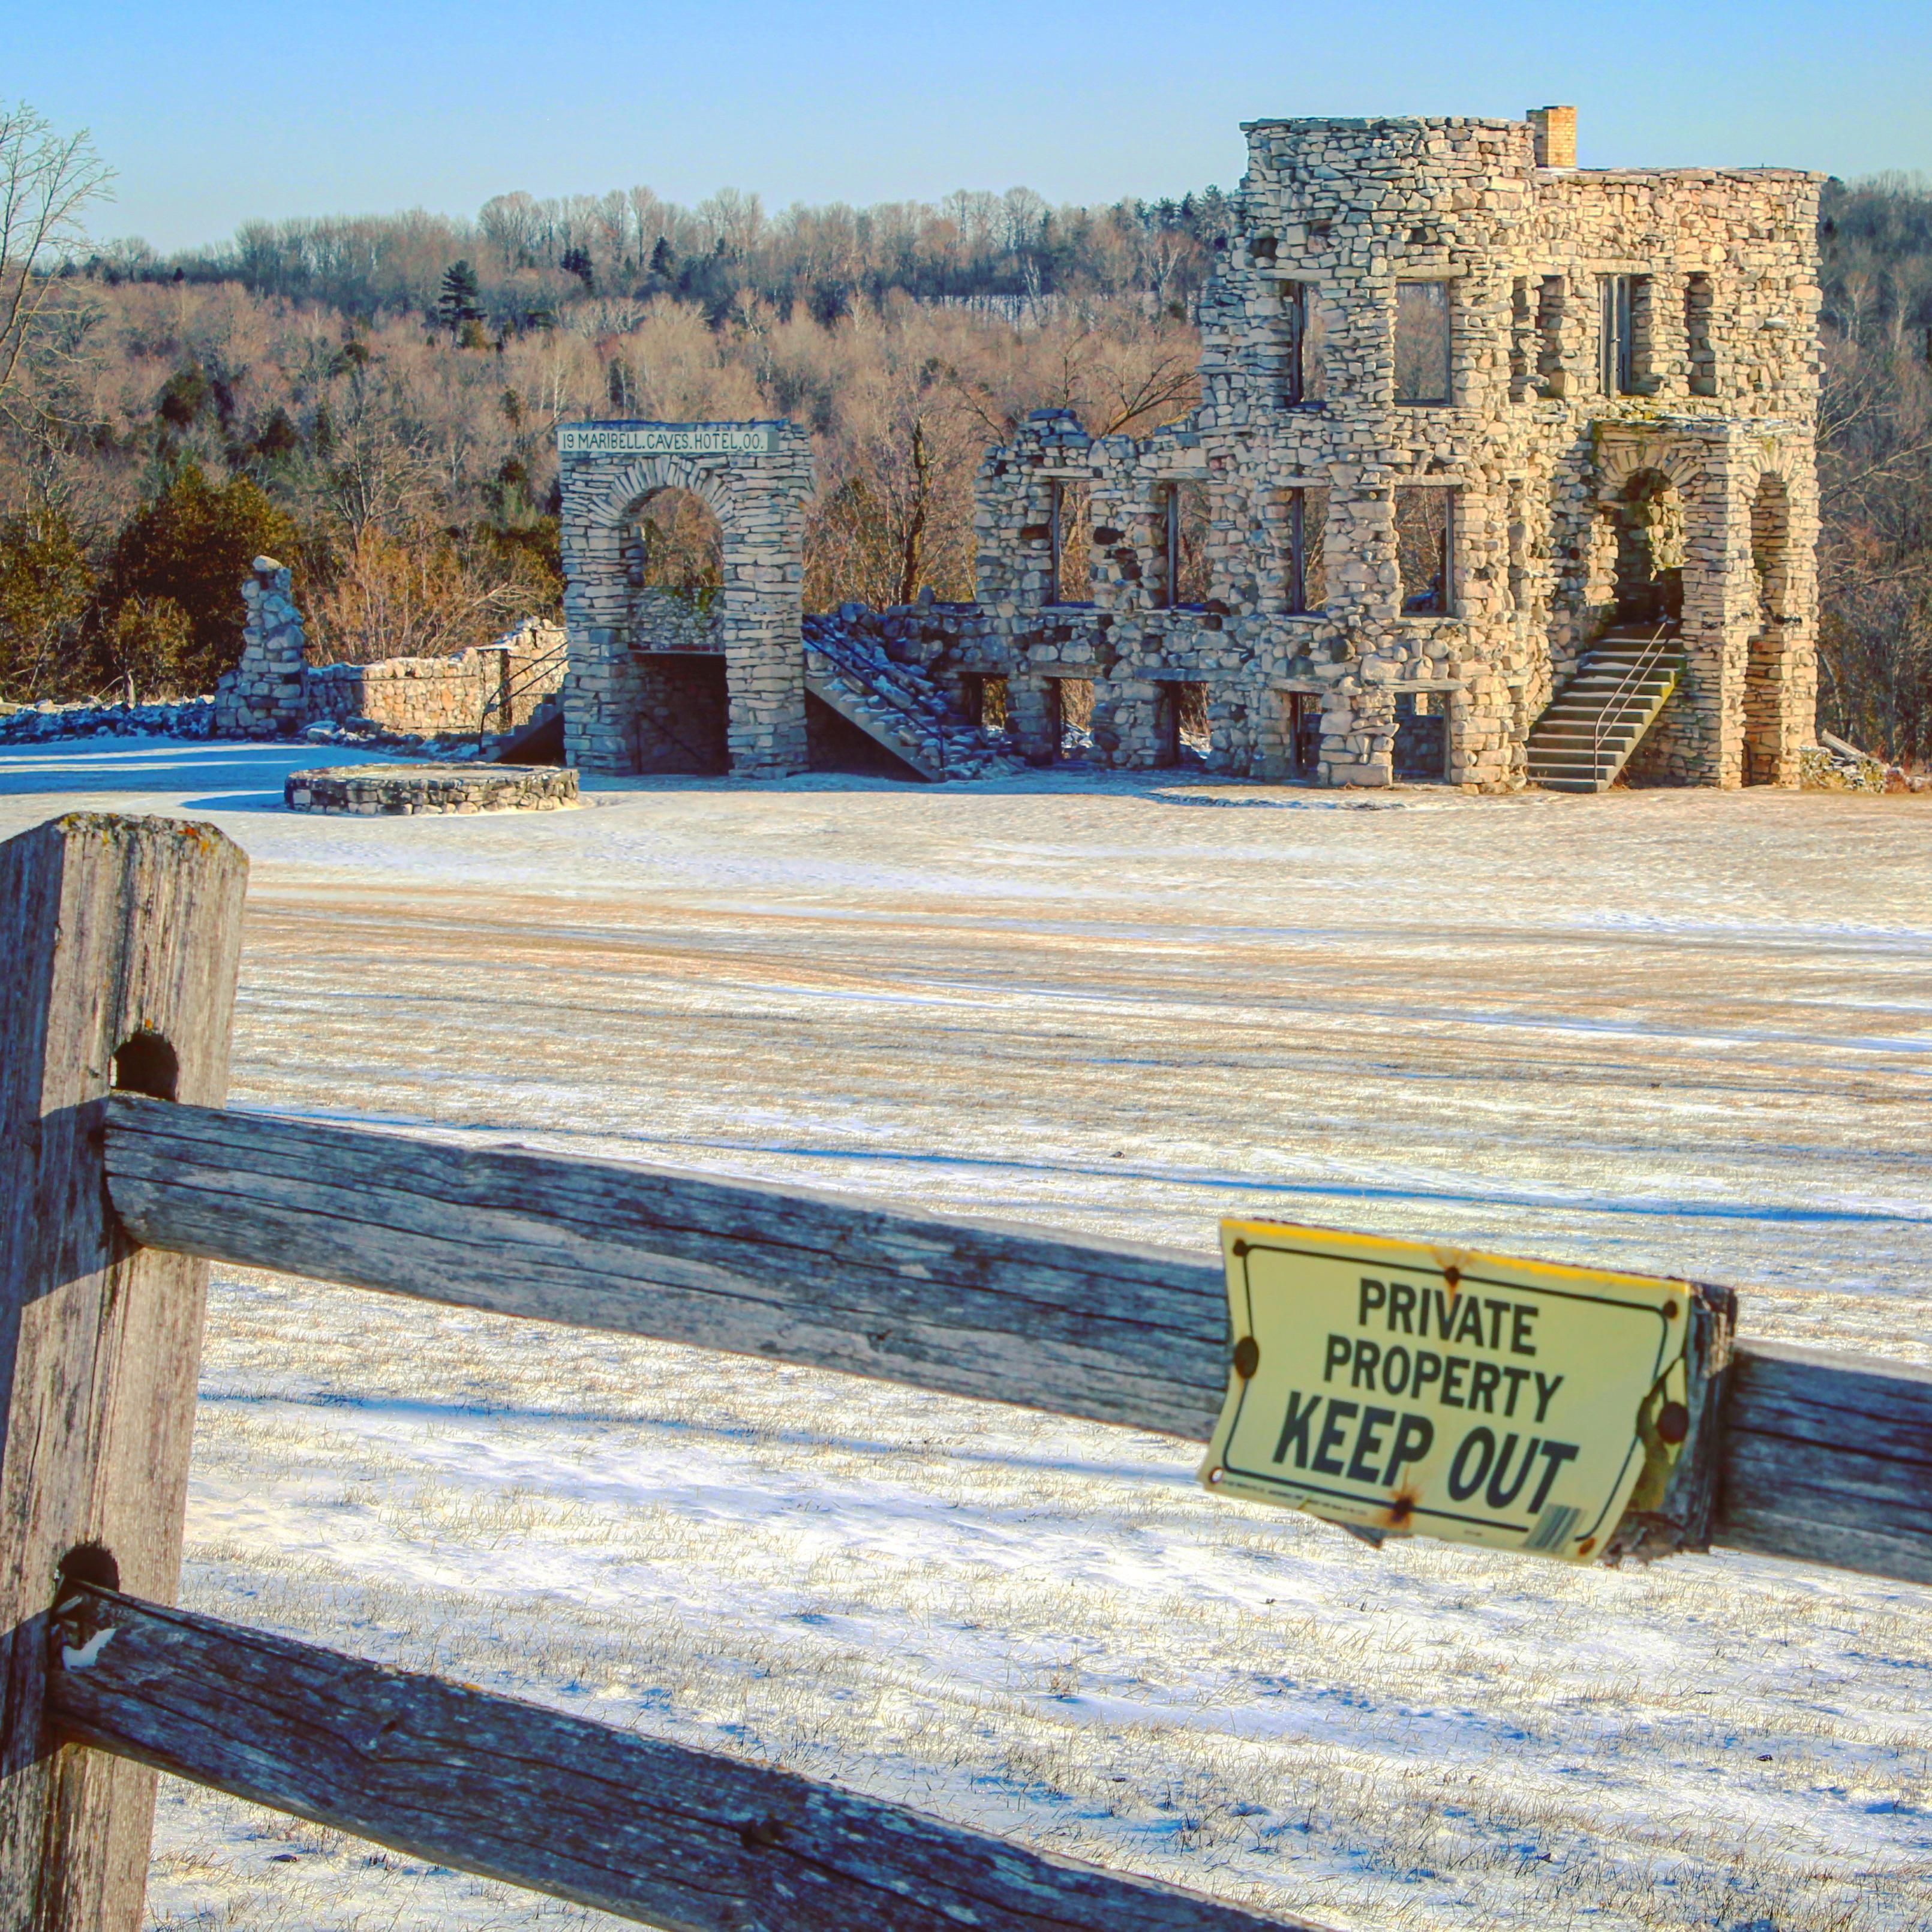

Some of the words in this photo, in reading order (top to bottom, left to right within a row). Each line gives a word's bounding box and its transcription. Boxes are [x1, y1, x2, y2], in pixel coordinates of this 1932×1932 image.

[563, 433, 574, 449] 19
[1359, 1277, 1540, 1357] PRIVATE
[1323, 1333, 1564, 1423] PROPERTY
[1272, 1390, 1435, 1488] KEEP
[1447, 1426, 1580, 1515] OUT
